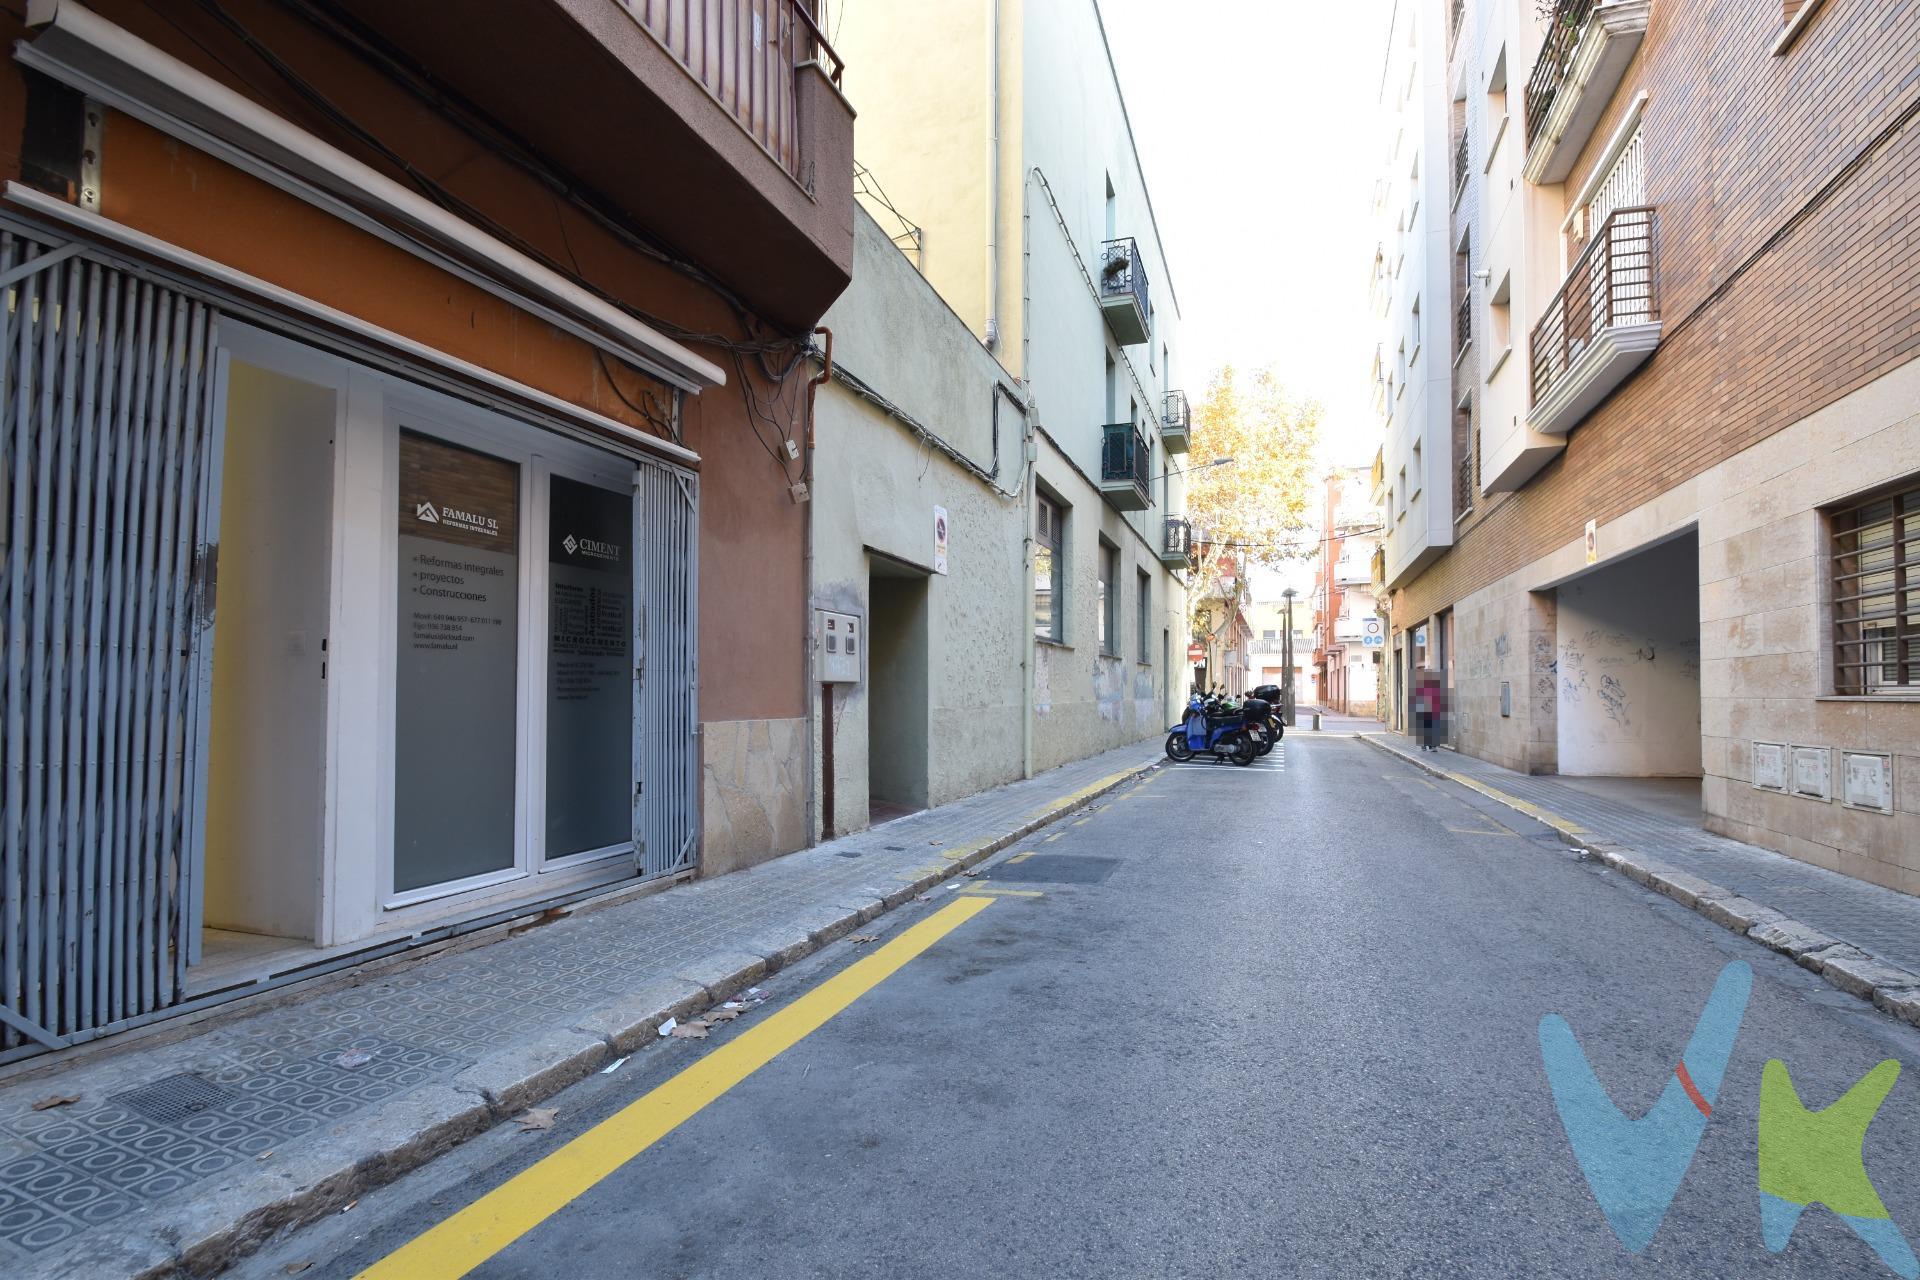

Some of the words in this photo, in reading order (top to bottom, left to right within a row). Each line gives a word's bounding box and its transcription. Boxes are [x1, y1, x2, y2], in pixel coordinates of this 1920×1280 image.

[442, 507, 485, 526] FAMALU
[487, 518, 499, 529] SL
[420, 554, 462, 570] Reformas
[464, 561, 504, 577] integrales
[420, 572, 465, 585] proyectos
[419, 585, 487, 602] Construcciones
[554, 635, 626, 647] MICROCEMENTO
